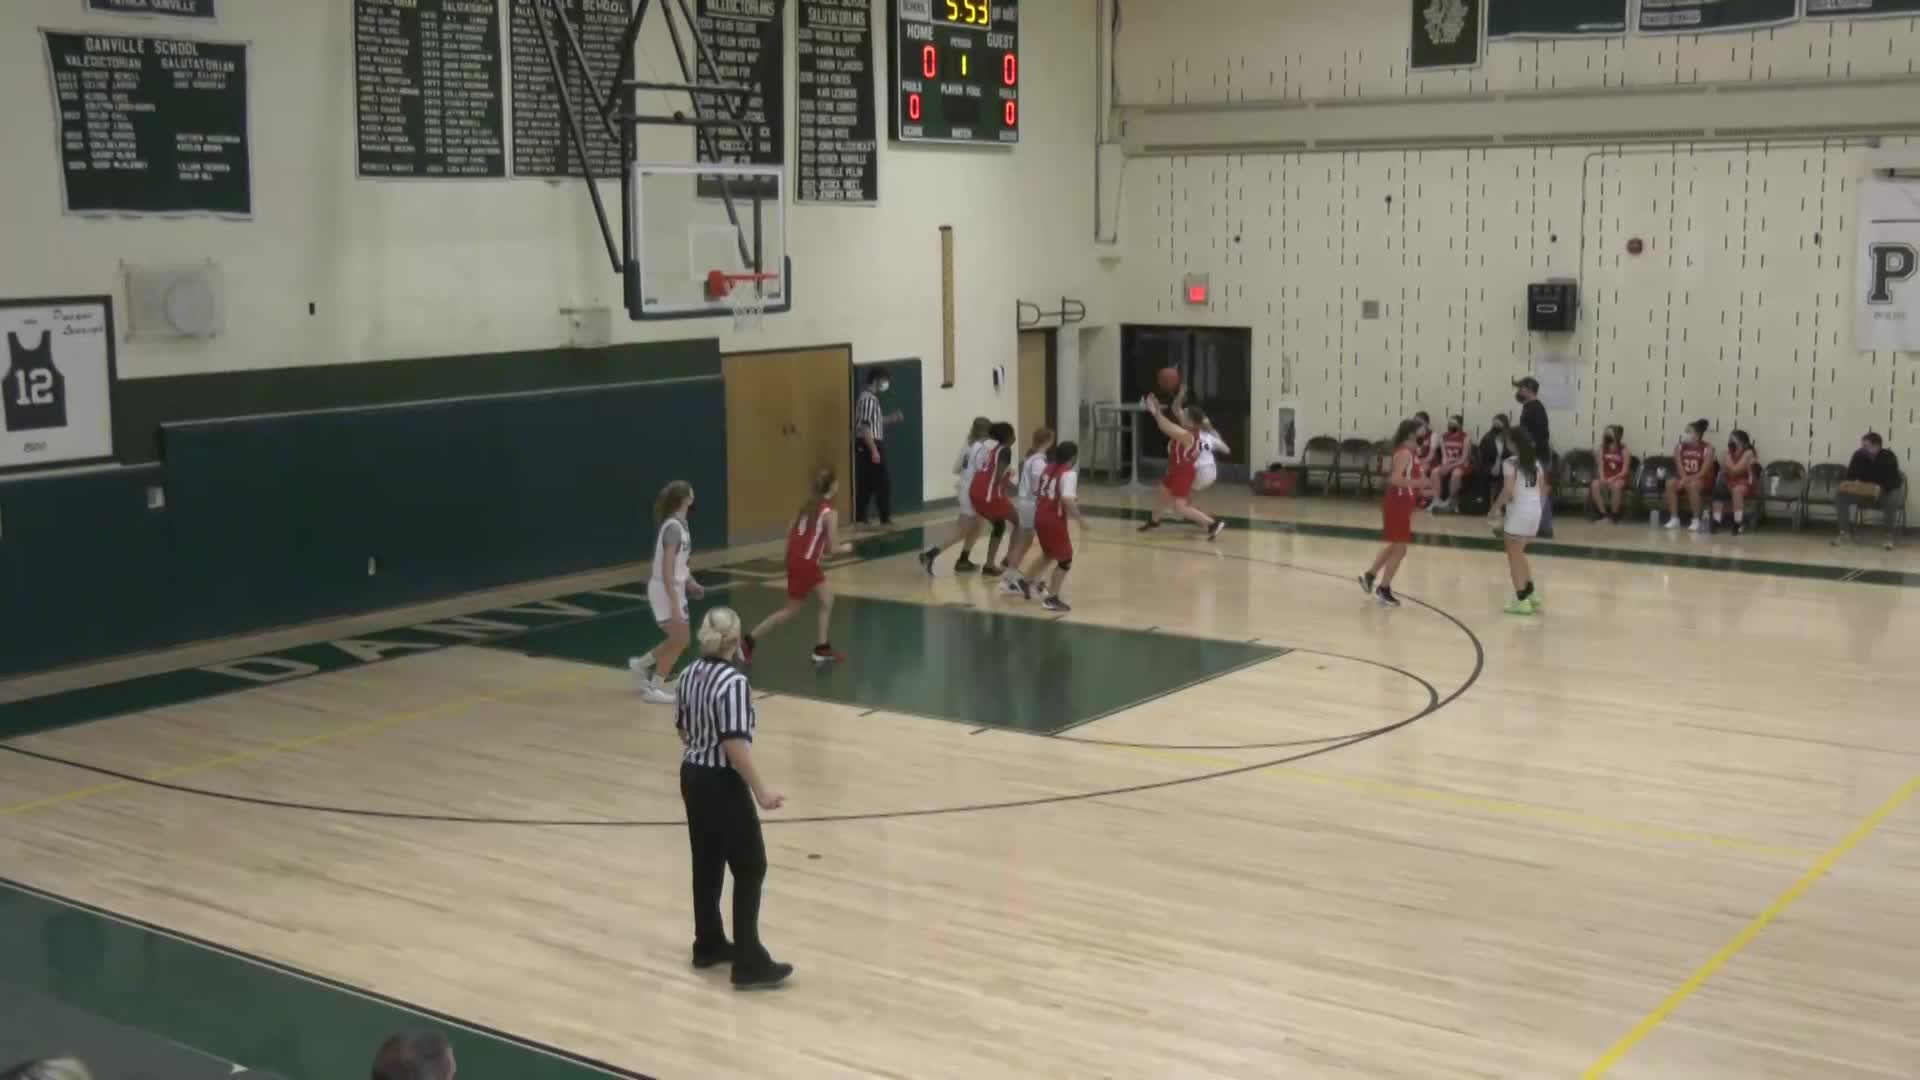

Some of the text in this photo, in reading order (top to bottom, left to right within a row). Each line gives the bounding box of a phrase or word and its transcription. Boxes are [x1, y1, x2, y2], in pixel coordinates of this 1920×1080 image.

[907, 23, 933, 40] HOME
[987, 32, 1014, 48] GUEST
[85, 37, 199, 56] DANVILLE SCHOOL
[64, 54, 142, 70] VALEDICTORIAN
[160, 57, 235, 73] SALUTATORIAN
[923, 45, 936, 78] 0
[961, 55, 967, 76] 1
[1004, 54, 1016, 85] 0
[940, 83, 981, 97] PLAYER FOUL
[910, 94, 920, 119] 0
[1006, 101, 1015, 125] 0
[1867, 242, 1918, 304] P
[16, 367, 54, 406] 12
